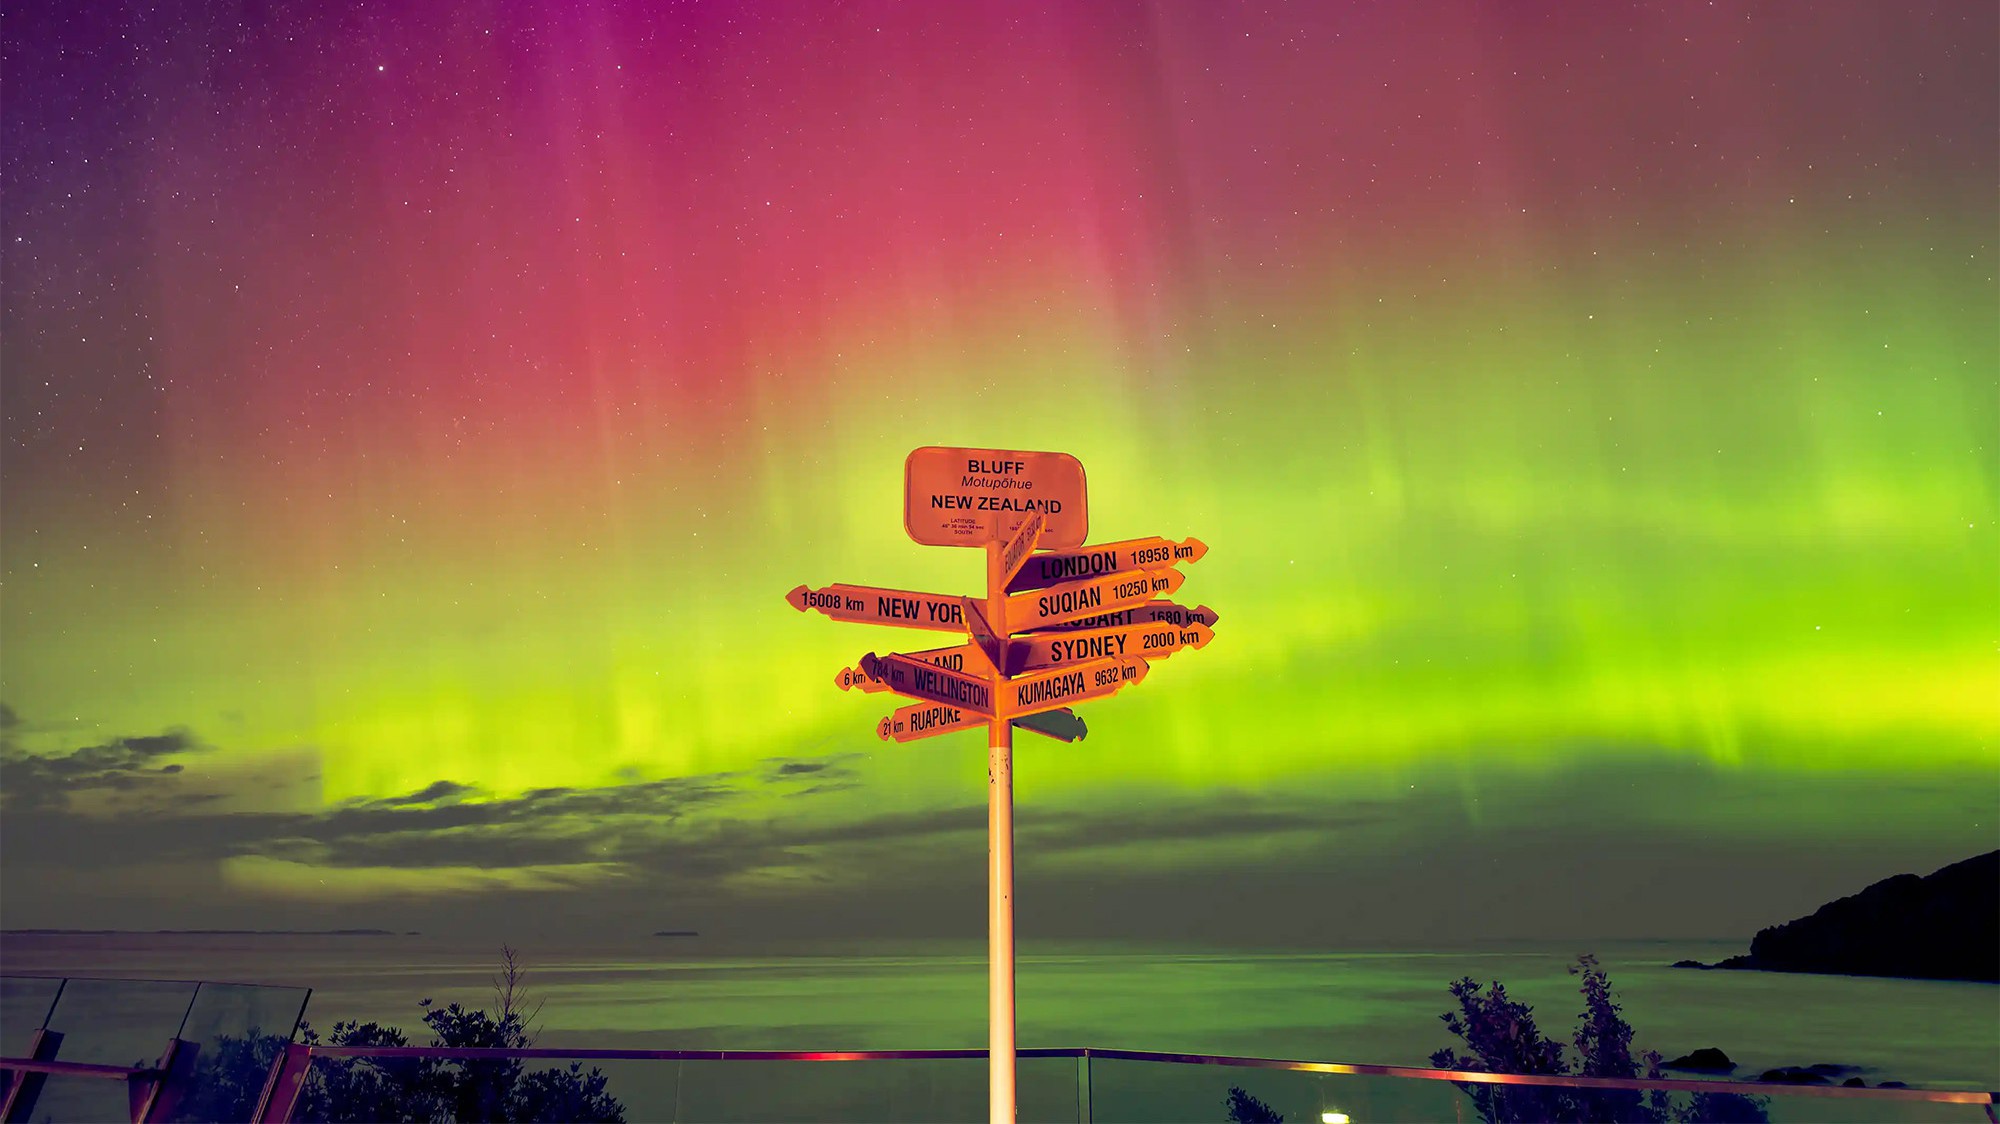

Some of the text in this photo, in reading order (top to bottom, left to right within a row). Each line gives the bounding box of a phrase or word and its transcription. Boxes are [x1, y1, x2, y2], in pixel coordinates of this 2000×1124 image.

[968, 460, 1024, 475] BLUFF
[931, 495, 1062, 514] NEW ZEALAND
[1041, 544, 1193, 580] LONDON 18958 km
[801, 592, 841, 609] 15008
[845, 596, 864, 612] km
[878, 596, 920, 620] NEW
[1038, 577, 1169, 617] SUQIAN 10250 km
[1149, 610, 1181, 625] 1680
[1185, 610, 1205, 625] km
[1051, 630, 1200, 662] SYDNEY 2000 km
[844, 673, 850, 686] 6
[853, 672, 866, 685] km
[871, 659, 989, 708] 784 km WELLINGTON
[1018, 665, 1137, 707] KUMAGAYA 9632 km
[883, 706, 961, 736] 21 km RUAPUKE
